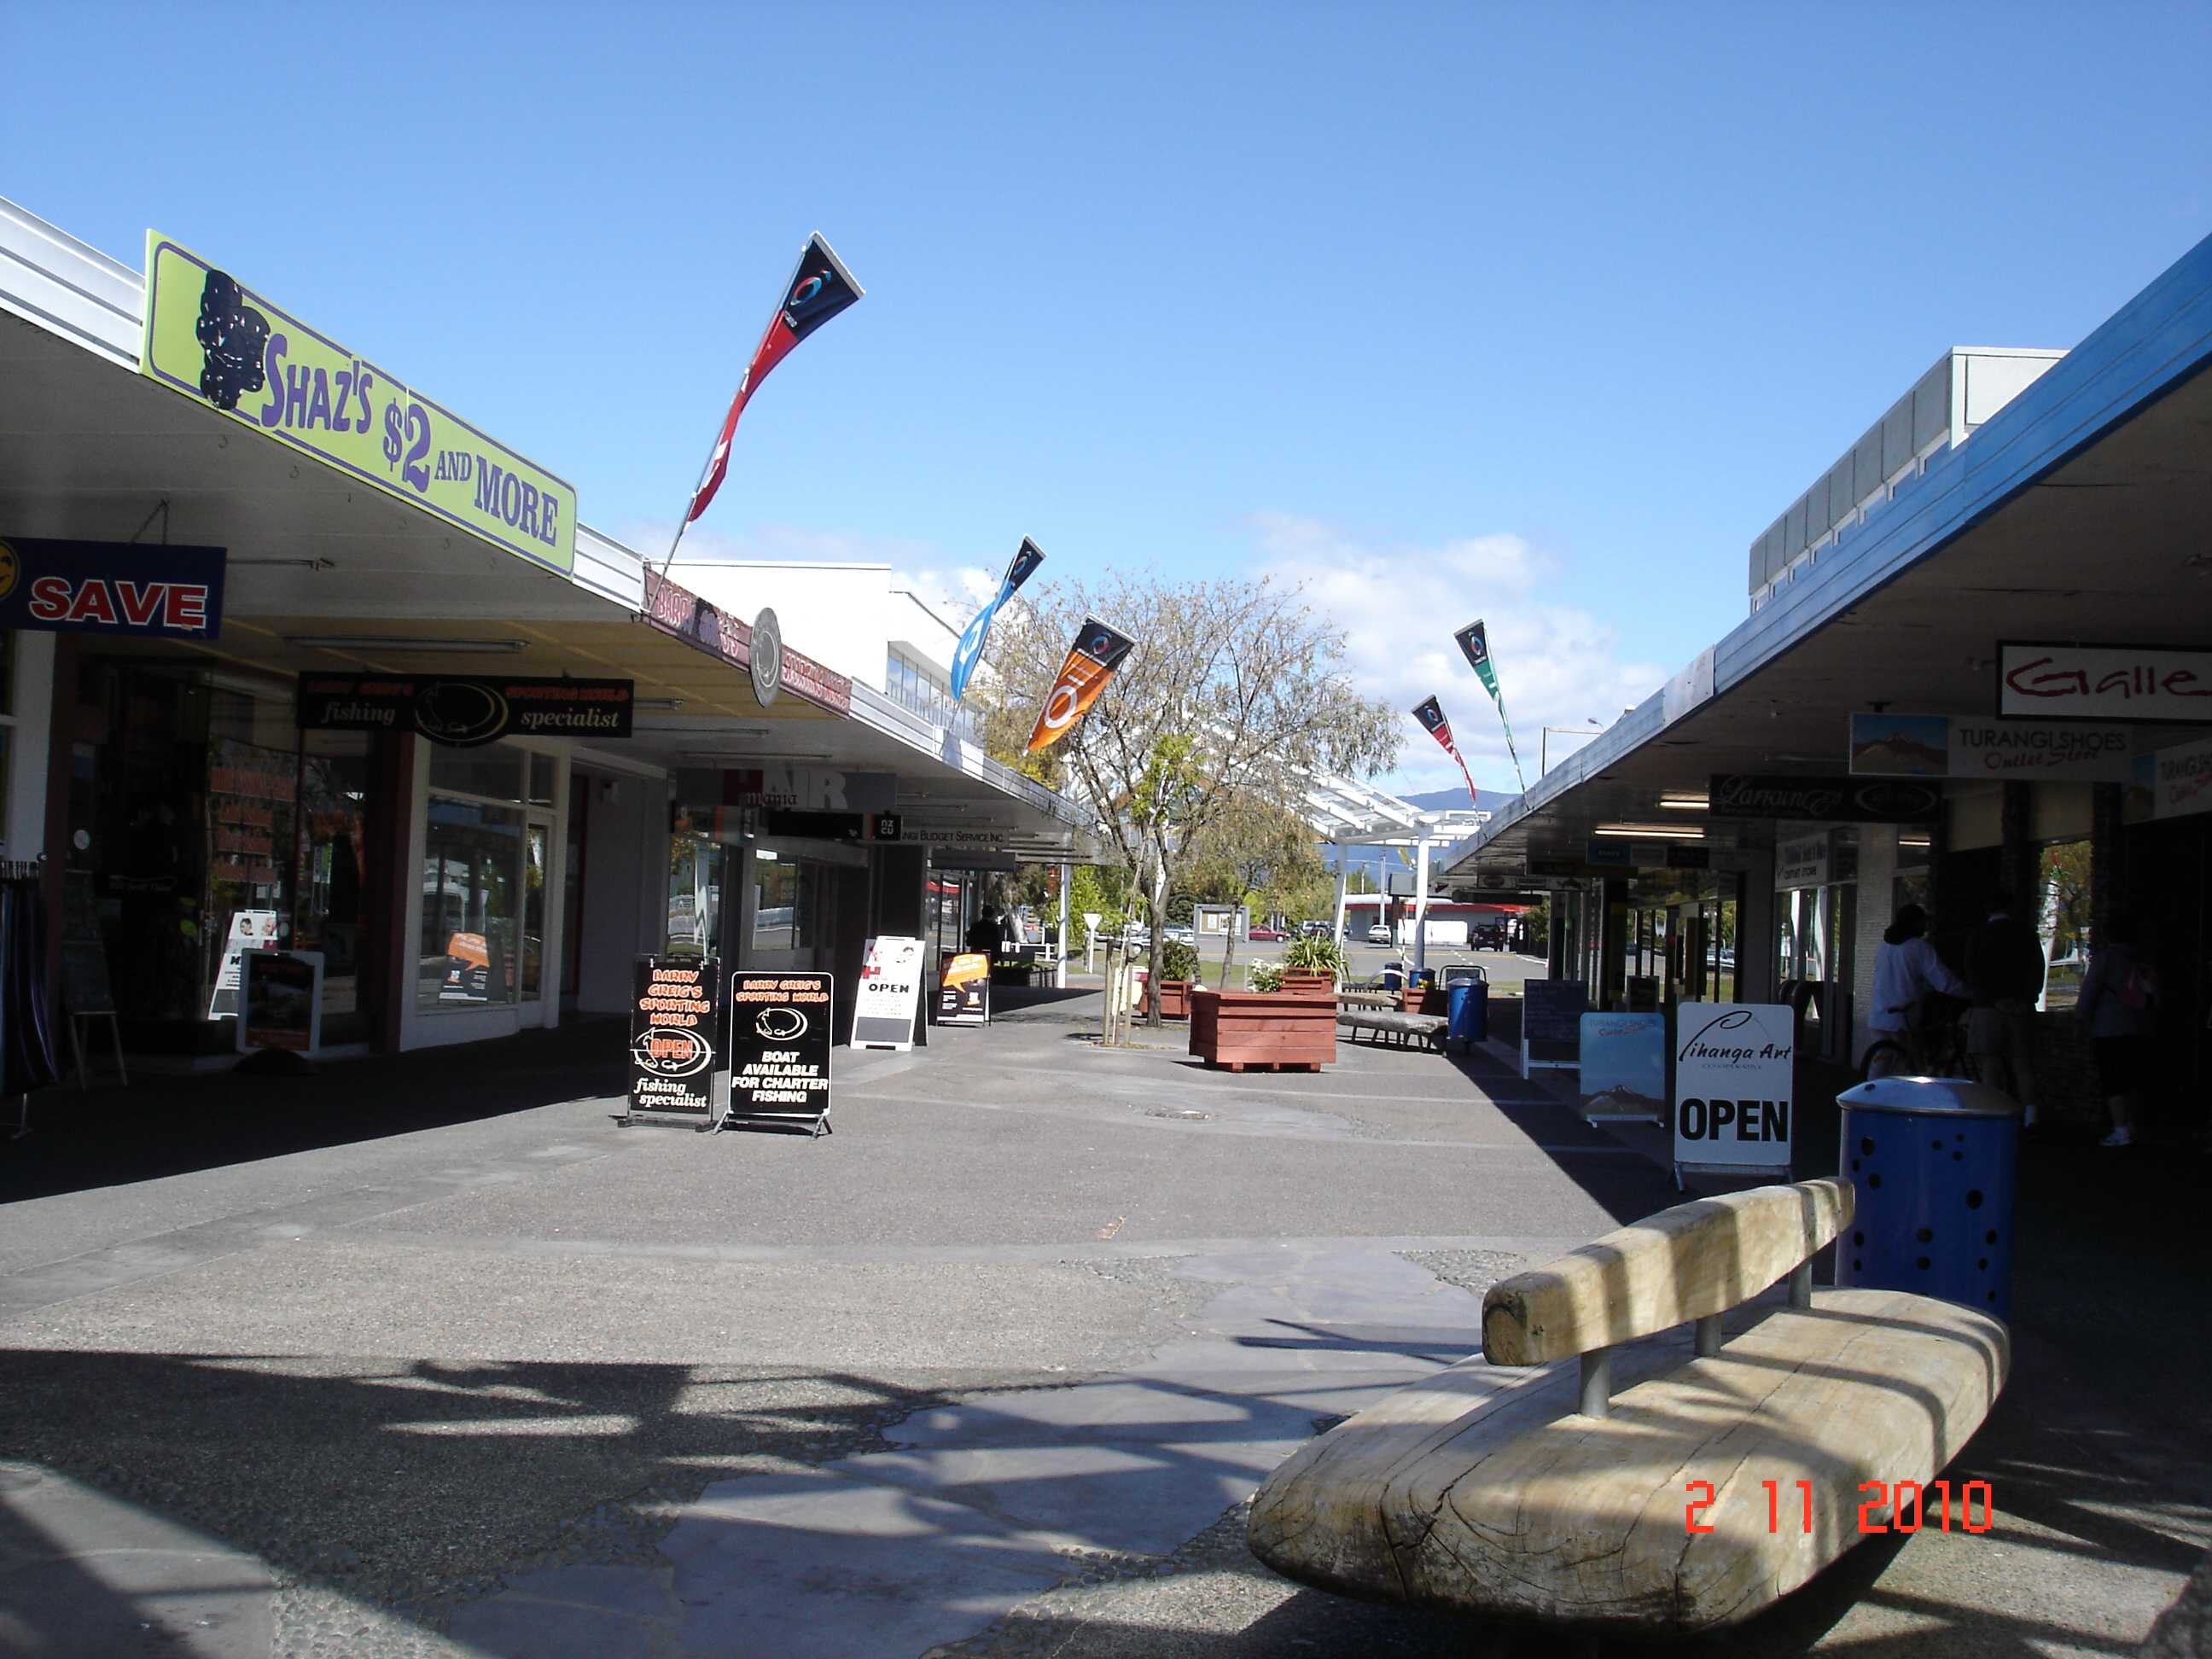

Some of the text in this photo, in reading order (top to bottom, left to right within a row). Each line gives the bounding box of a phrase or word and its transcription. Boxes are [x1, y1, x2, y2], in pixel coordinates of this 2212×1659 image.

[382, 397, 432, 494] $2
[434, 449, 473, 484] AND
[473, 454, 560, 548] MORE
[28, 575, 209, 630] SAVE
[320, 700, 620, 730] fishing specialist
[1959, 728, 2127, 751] TURANGI SHOES
[1984, 751, 2042, 770] Outlet
[920, 831, 953, 841] BUDGET
[955, 832, 988, 841] SERVICE
[652, 969, 699, 983] BARRY
[648, 983, 703, 998] GREIG'S
[742, 980, 822, 991] BARRY GREIG'S
[868, 982, 910, 994] OPEN
[736, 991, 830, 1003] SPORTING WORLD
[639, 997, 710, 1013] SPORTING
[649, 1012, 698, 1027] WORLD
[649, 1038, 694, 1059] OPEN
[1760, 1043, 1792, 1060] Art
[761, 1051, 800, 1063] BOAT
[742, 1063, 819, 1077] AVAILABLE
[633, 1077, 687, 1095] fishing
[731, 1076, 830, 1091] FOR CHARTER
[638, 1091, 707, 1109] specialist
[751, 1090, 807, 1103] FISHING
[1679, 1097, 1789, 1143] OPEN
